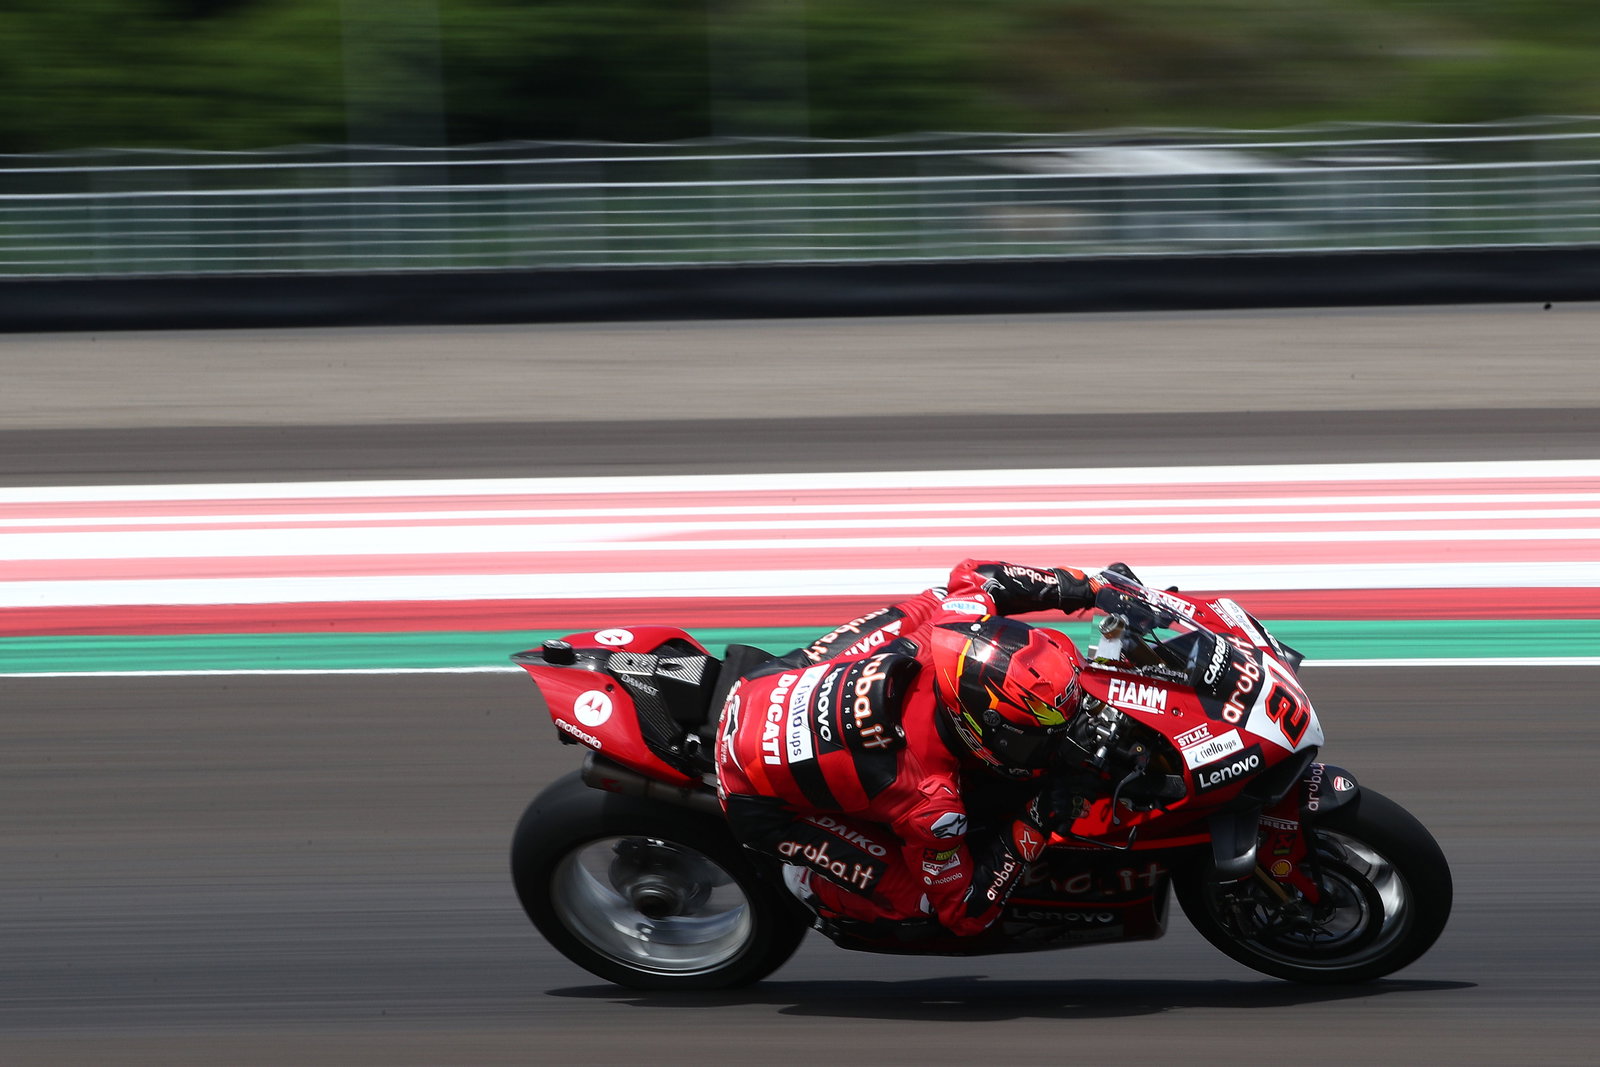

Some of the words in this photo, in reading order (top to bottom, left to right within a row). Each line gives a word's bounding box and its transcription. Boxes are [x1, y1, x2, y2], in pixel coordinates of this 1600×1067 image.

[817, 666, 845, 742] Lenovo
[854, 652, 893, 749] ruba.it
[1107, 678, 1168, 710] FIAMM
[554, 718, 602, 750] motorola
[762, 673, 799, 766] DUCATI
[1177, 727, 1209, 746] STULZ
[789, 735, 801, 757] ups
[1200, 741, 1223, 759] riello
[1223, 739, 1237, 751] ups
[1198, 754, 1259, 788] Lenovo
[777, 841, 874, 890] aruba.it
[986, 853, 1015, 901] aruba.i
